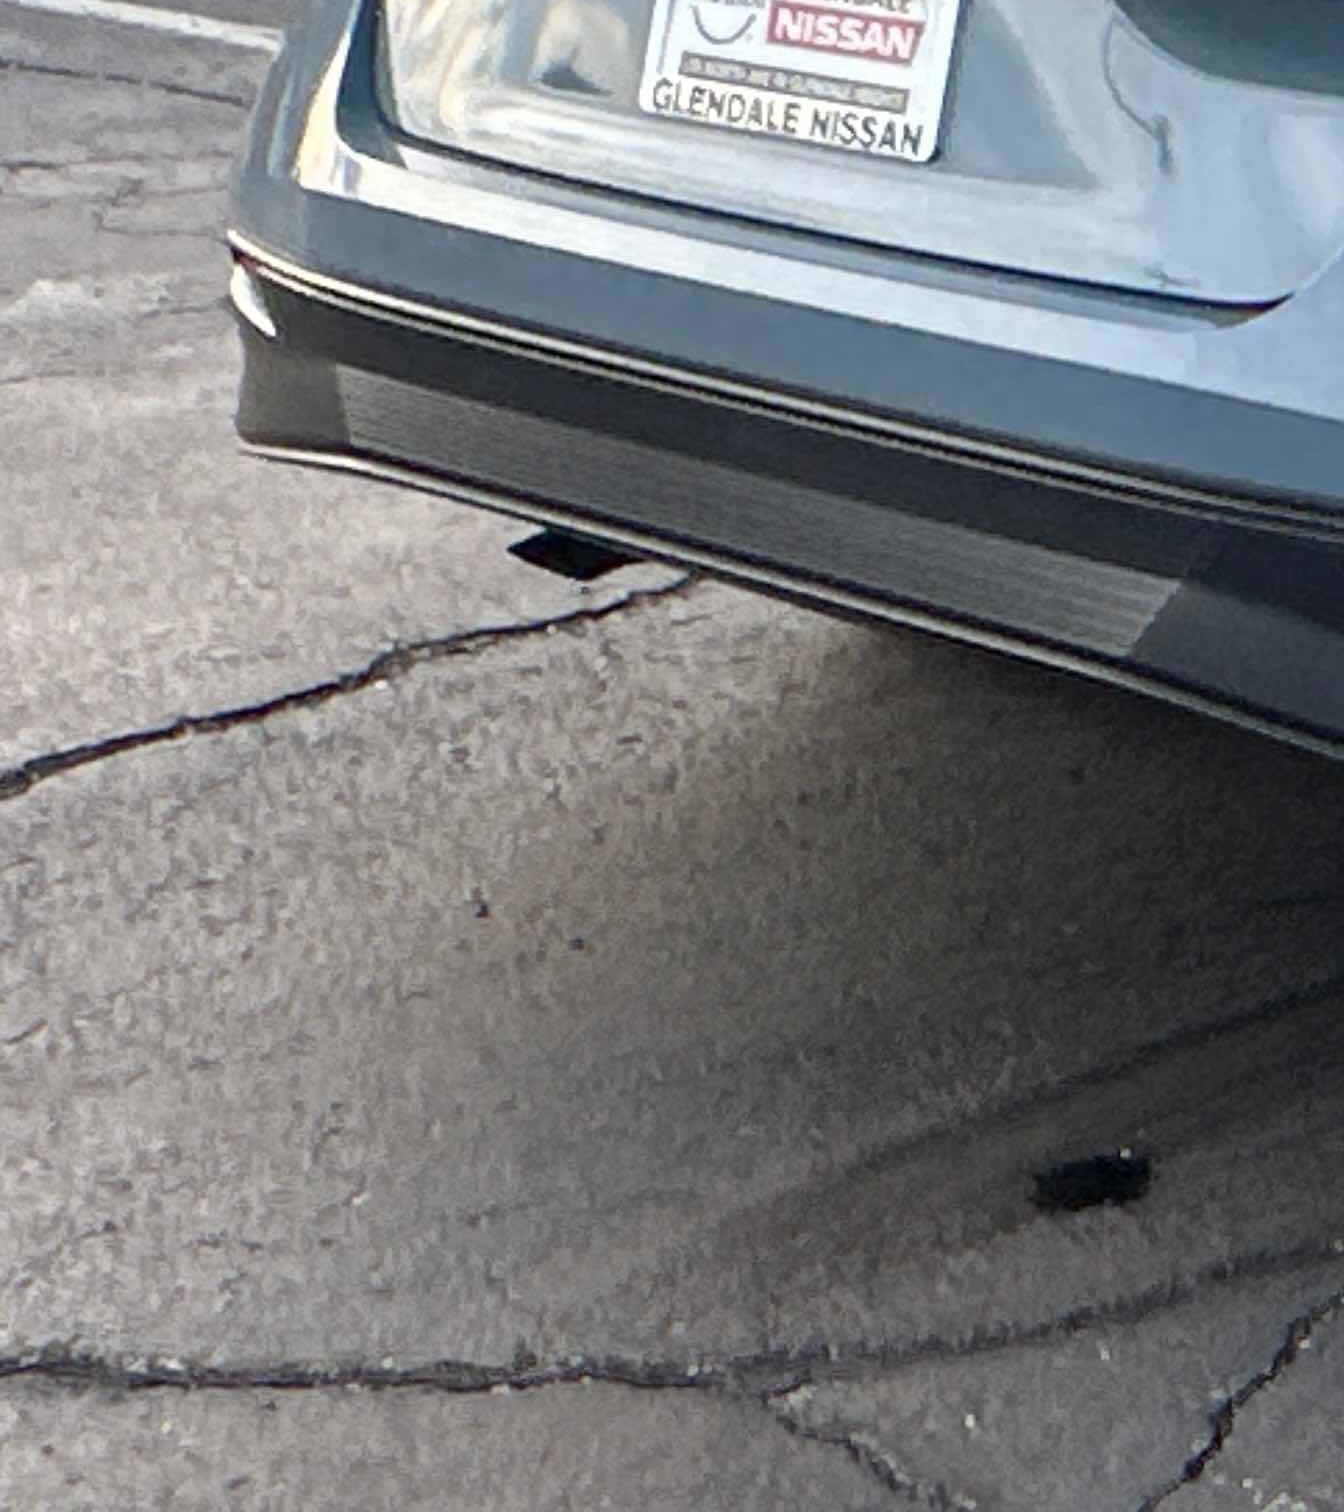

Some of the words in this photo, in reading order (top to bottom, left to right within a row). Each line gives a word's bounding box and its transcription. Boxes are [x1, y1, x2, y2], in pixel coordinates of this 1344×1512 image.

[774, 7, 916, 59] NISSAN
[652, 77, 802, 134] GLENDALE
[809, 107, 923, 157] NISSAN
